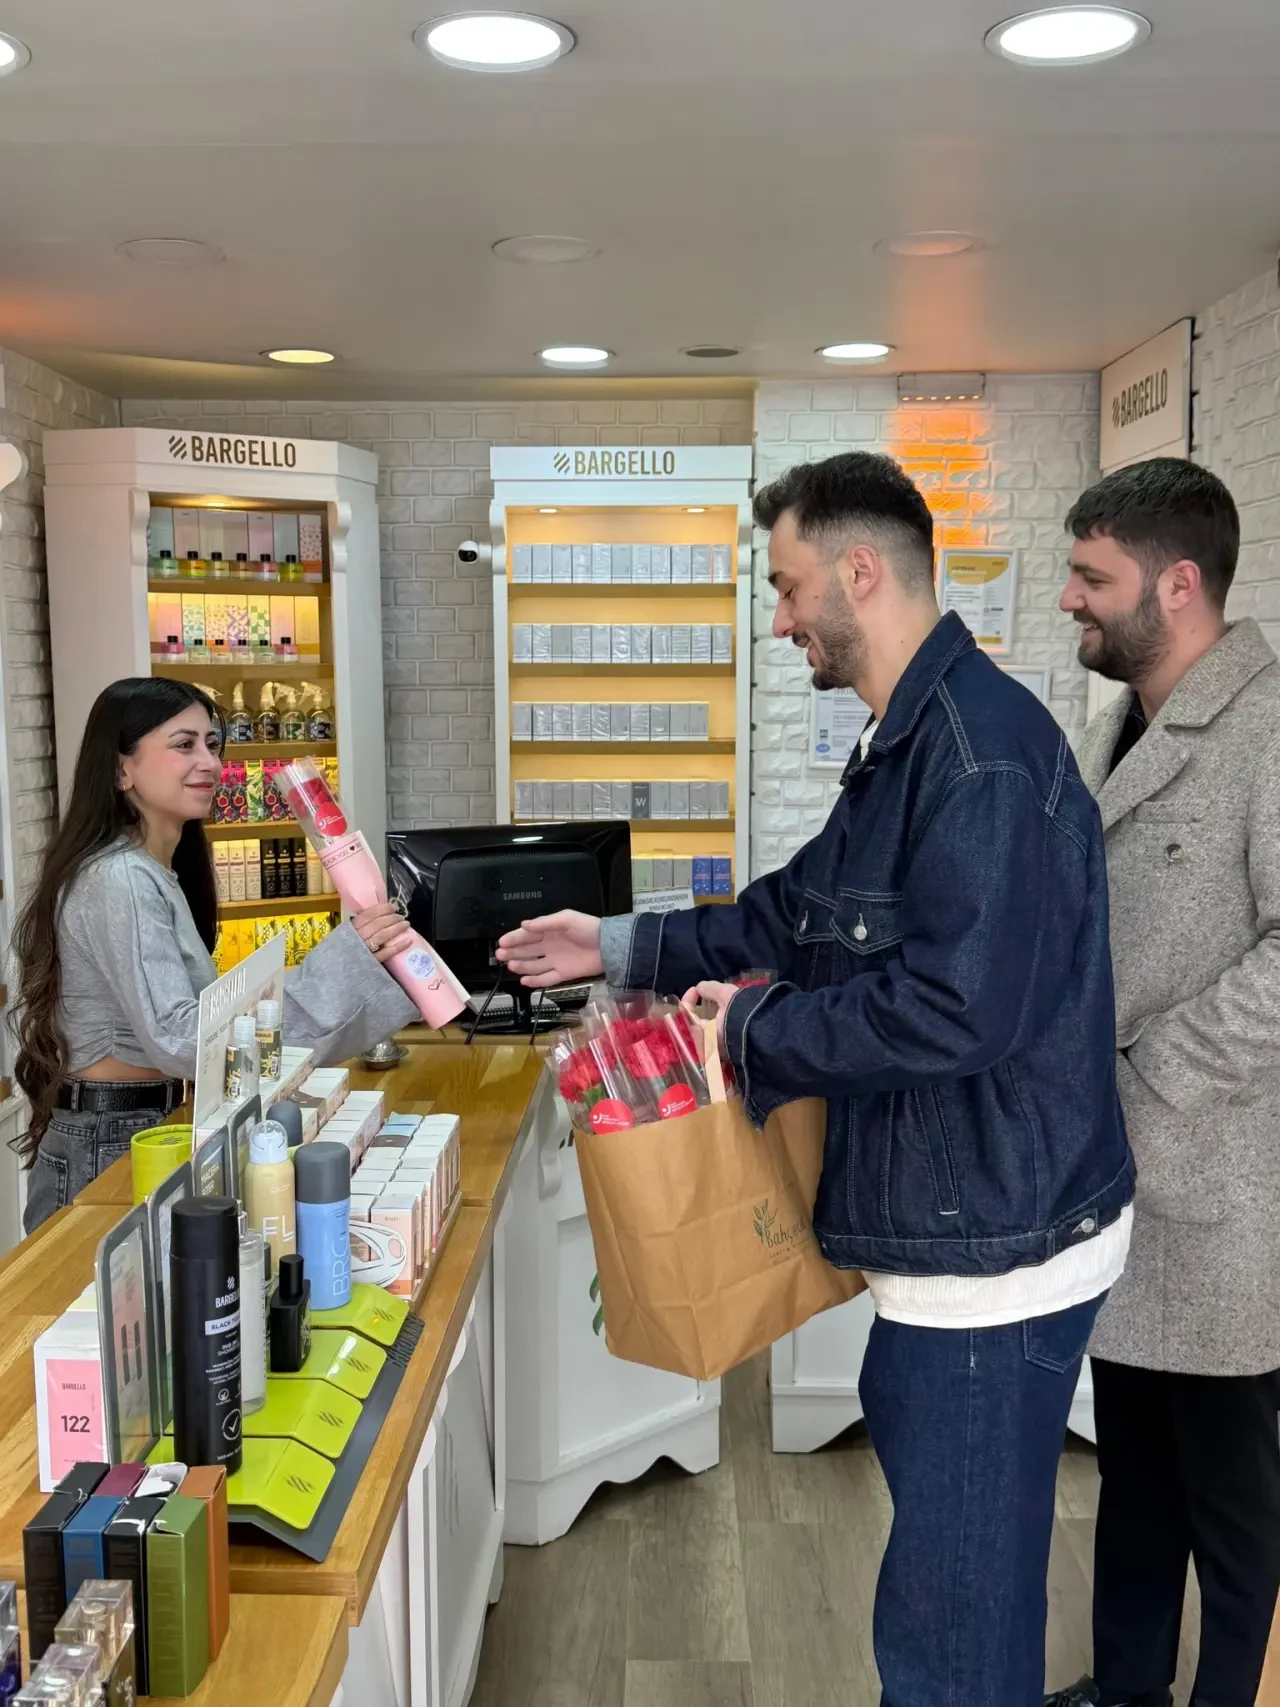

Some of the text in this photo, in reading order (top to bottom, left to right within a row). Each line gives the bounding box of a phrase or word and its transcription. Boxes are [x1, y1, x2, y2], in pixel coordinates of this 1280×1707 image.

[1120, 367, 1168, 428] BARGELLO
[191, 435, 296, 468] BARGELLO
[574, 450, 675, 475] BARGELLO
[503, 890, 542, 900] SAMSUNG
[210, 1320, 231, 1331] BLACK
[61, 1383, 86, 1391] BARGELLO
[60, 1415, 91, 1433] 122
